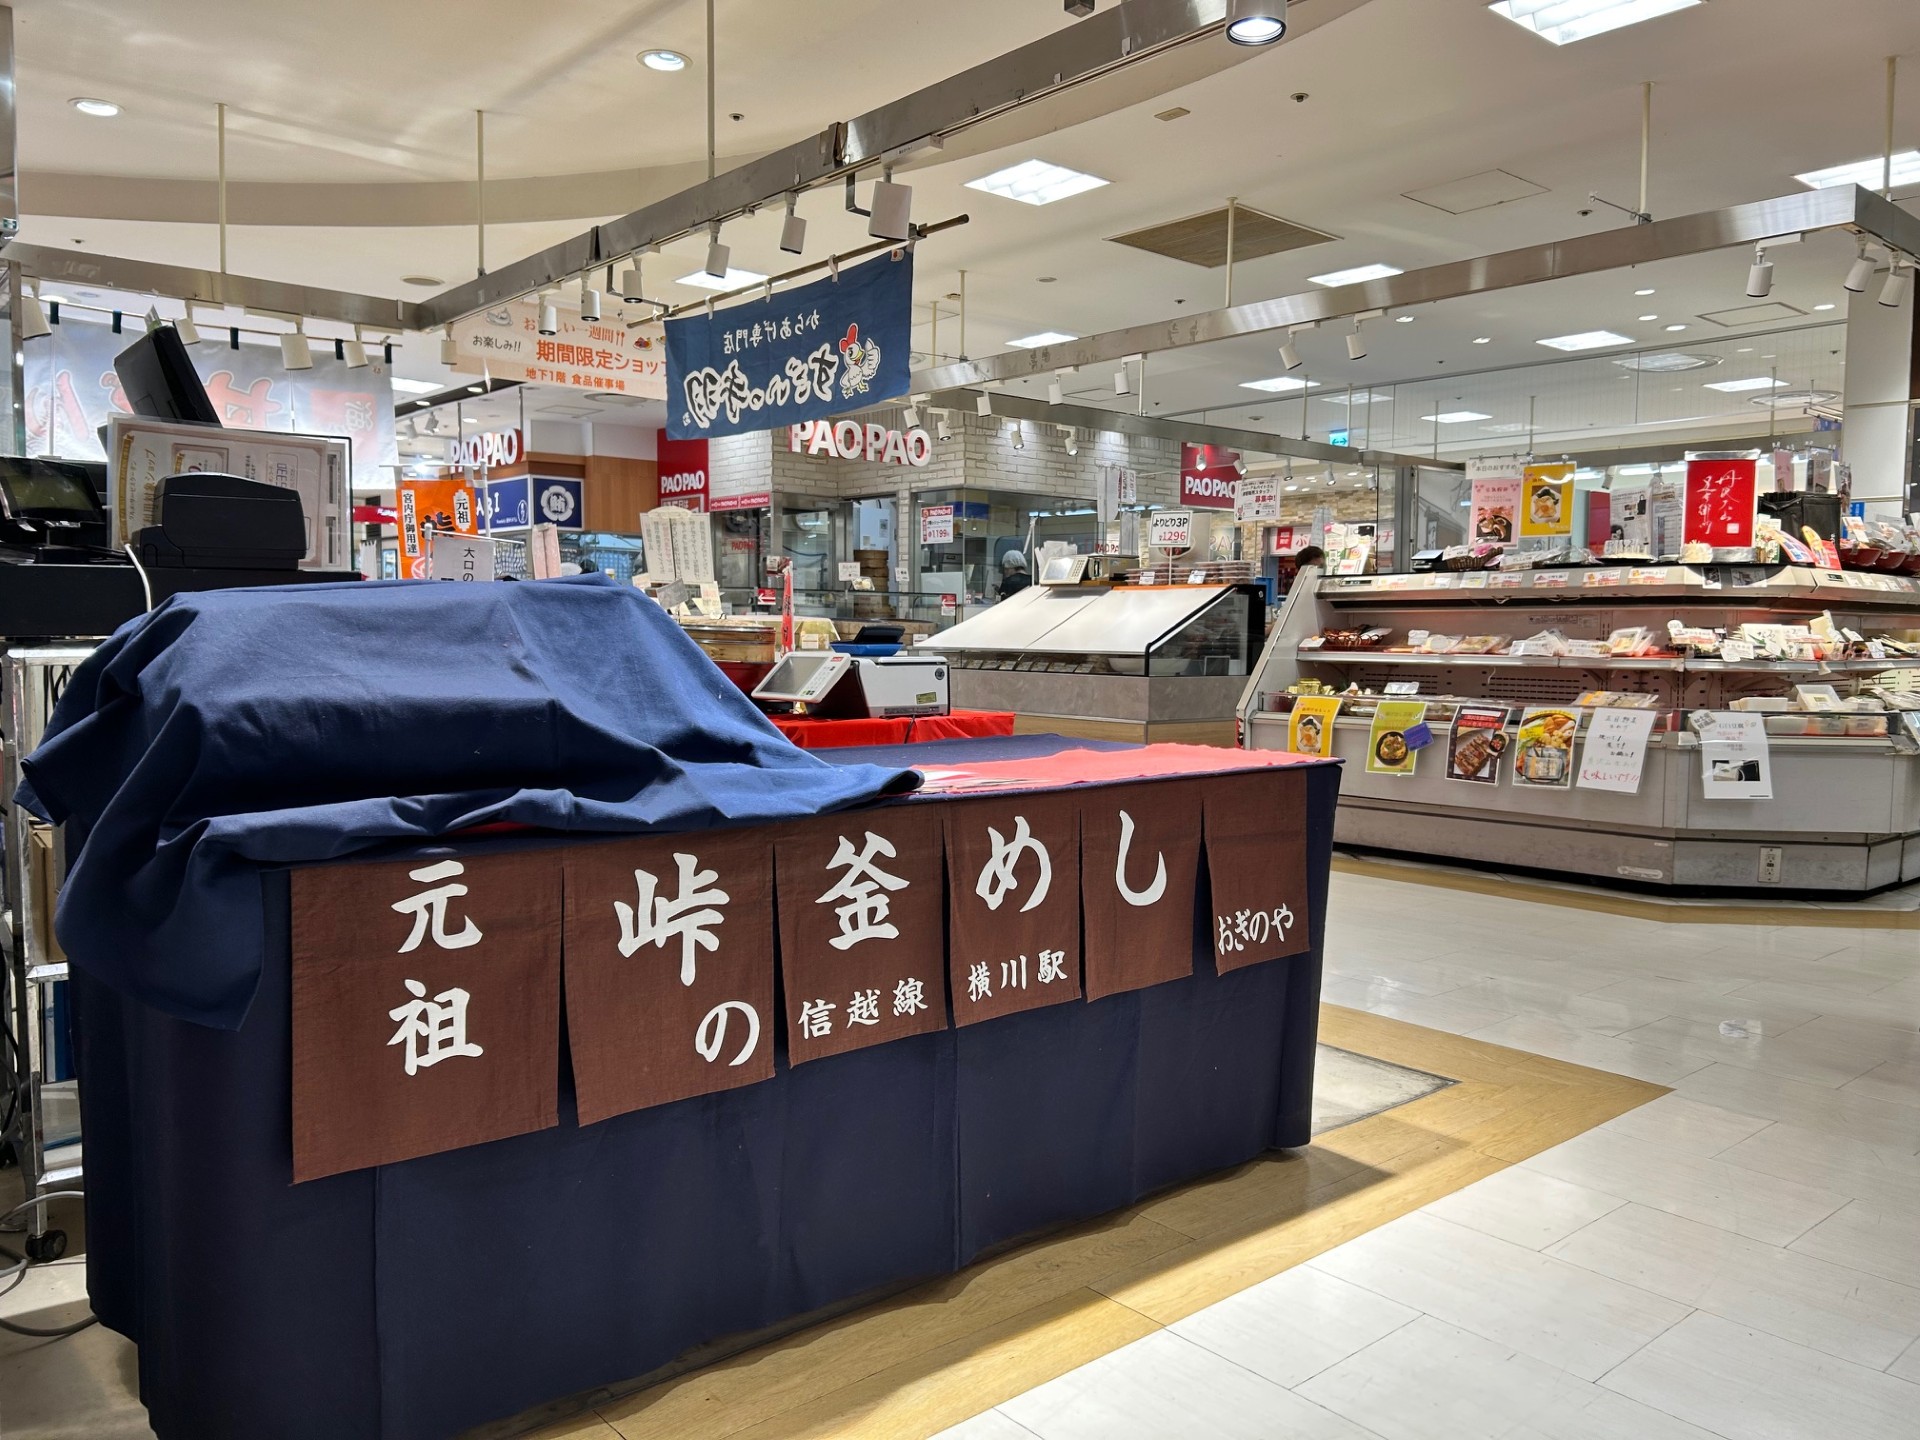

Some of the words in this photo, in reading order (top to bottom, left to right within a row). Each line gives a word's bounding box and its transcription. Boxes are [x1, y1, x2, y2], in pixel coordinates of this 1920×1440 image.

[524, 317, 614, 343] おい一週間
[525, 367, 567, 384] 地下1階
[571, 373, 625, 391] 食品催事場
[450, 428, 519, 473] PAOPAO
[790, 420, 932, 467] PAOPAO
[660, 470, 705, 494] PAOPAO
[1184, 476, 1237, 499] PAOPAO
[402, 492, 418, 554] 宮内庁御用達
[456, 498, 471, 524] 元祖
[1153, 517, 1188, 528] よりどり3P
[1216, 902, 1295, 956] おぎのや
[386, 859, 484, 1076] 元祖
[797, 977, 929, 1040] 信越線
[966, 948, 1069, 1002] 横川駅
